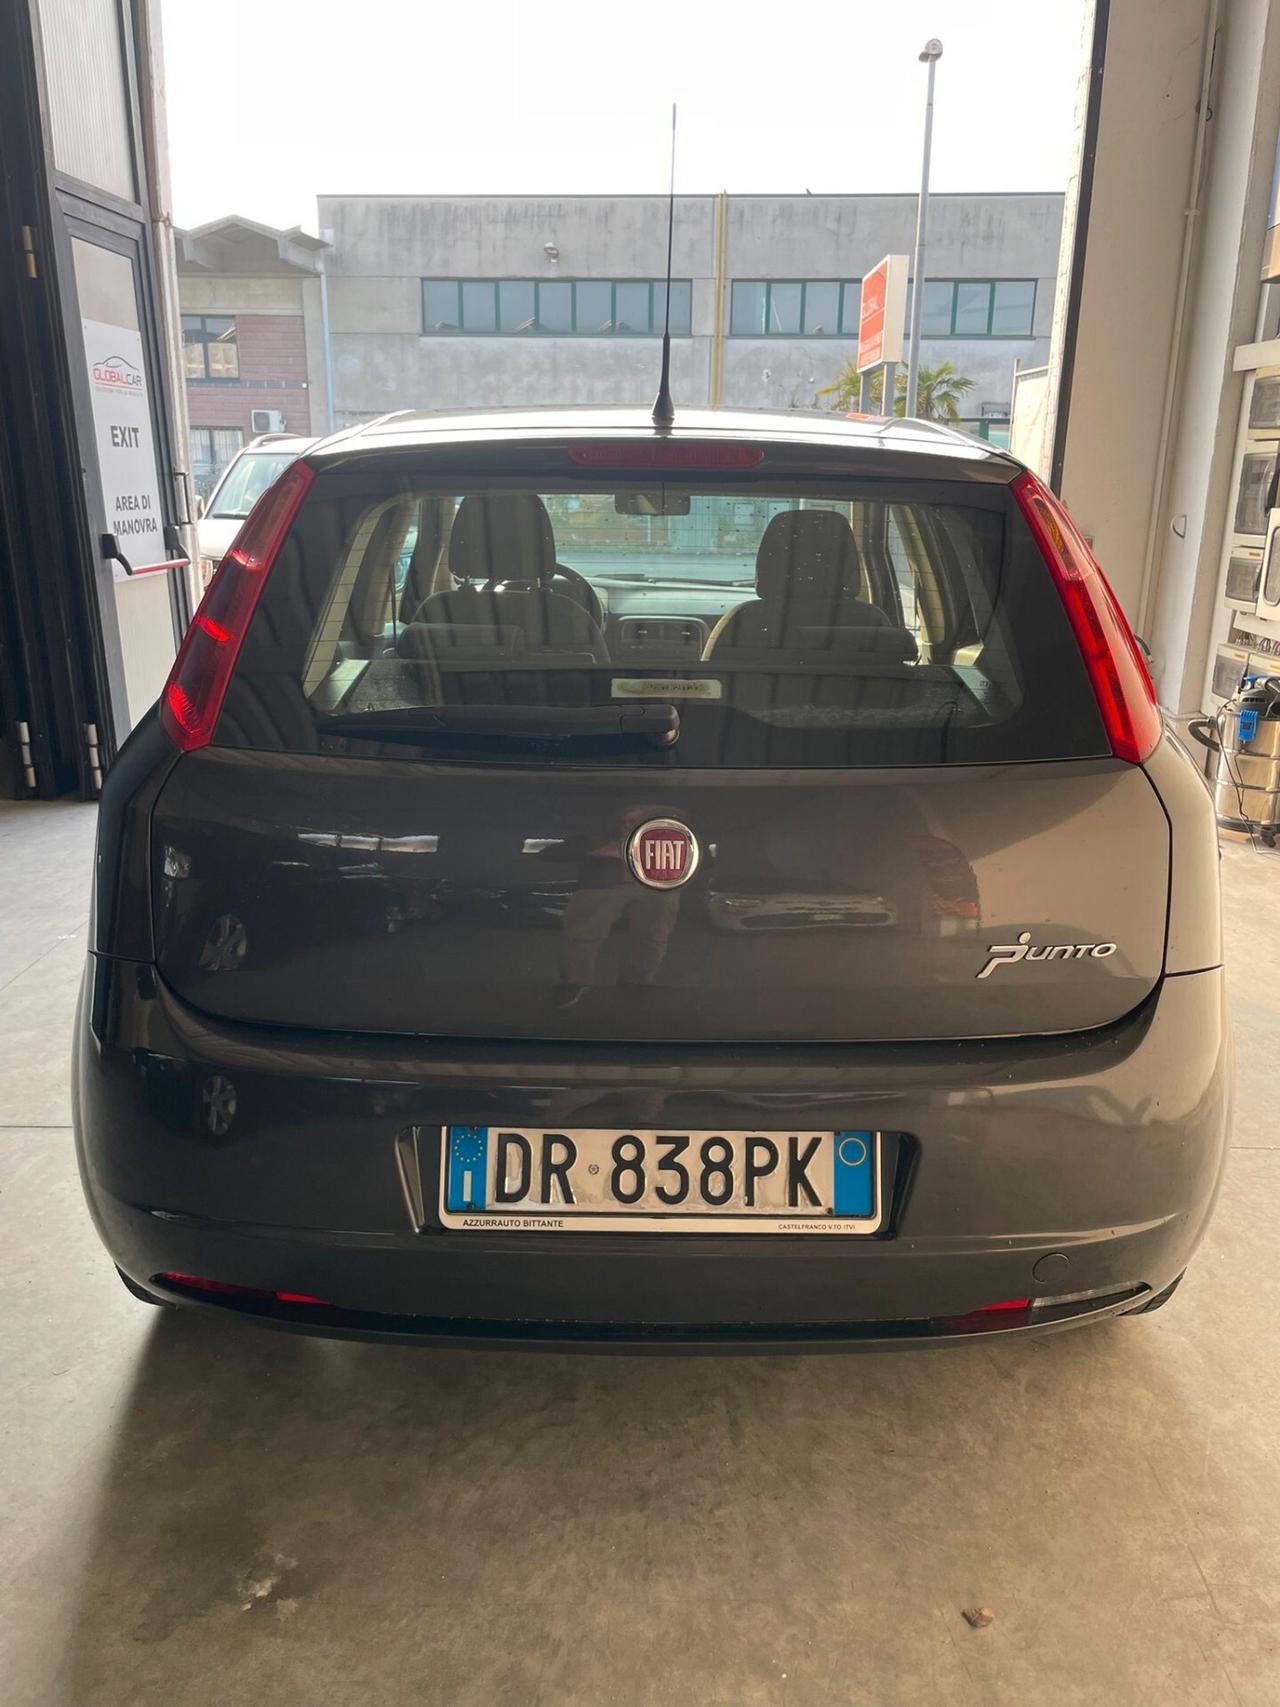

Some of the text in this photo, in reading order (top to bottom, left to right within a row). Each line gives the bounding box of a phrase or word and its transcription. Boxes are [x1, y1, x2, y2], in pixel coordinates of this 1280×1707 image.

[110, 425, 139, 448] EXIT
[116, 495, 151, 511] AREA DI
[113, 518, 158, 536] MANOVRA
[645, 840, 685, 870] FIAT
[494, 1132, 824, 1208] DR 838PK
[463, 1219, 564, 1228] AZZURRAUTO BITTANTE
